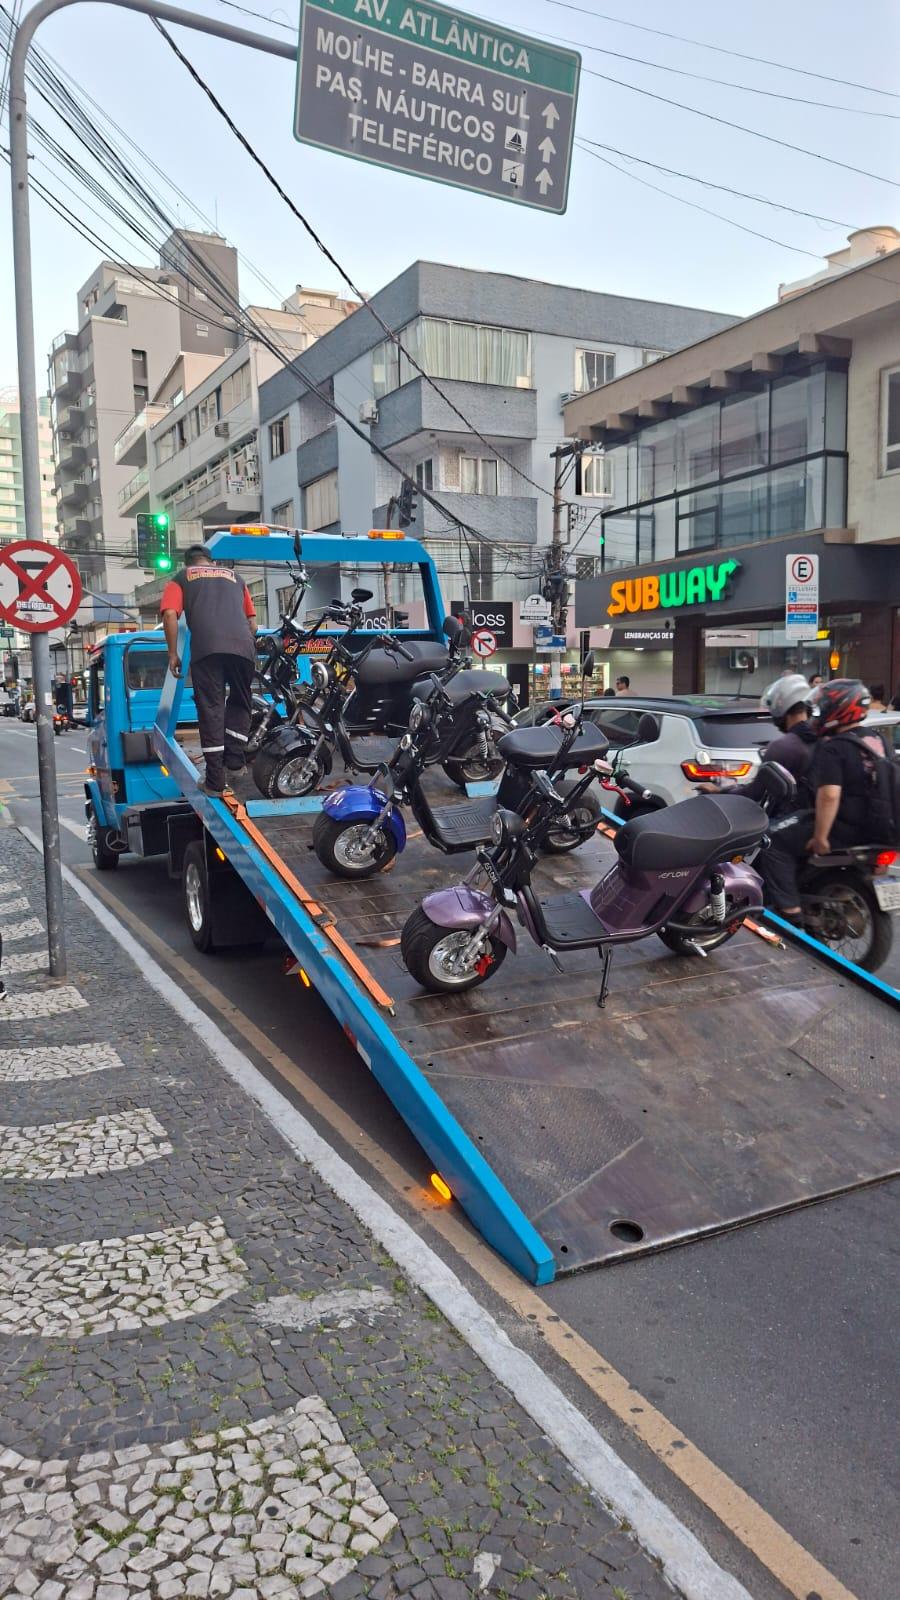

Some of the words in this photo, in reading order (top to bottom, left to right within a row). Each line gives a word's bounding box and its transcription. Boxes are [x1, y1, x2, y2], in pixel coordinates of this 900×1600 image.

[354, 0, 391, 25] AV.
[399, 7, 531, 73] ATLÂNTICA
[316, 28, 394, 77] MOLHE
[411, 62, 485, 106] BARRA
[492, 91, 530, 120] SUL
[316, 65, 368, 105] PAS.
[376, 86, 495, 143] NÁUTICOS
[349, 113, 493, 175] TELEFÉRICO
[607, 557, 738, 617] SUBWAY
[798, 561, 807, 577] E
[363, 612, 387, 630] loss
[471, 609, 506, 627] loss
